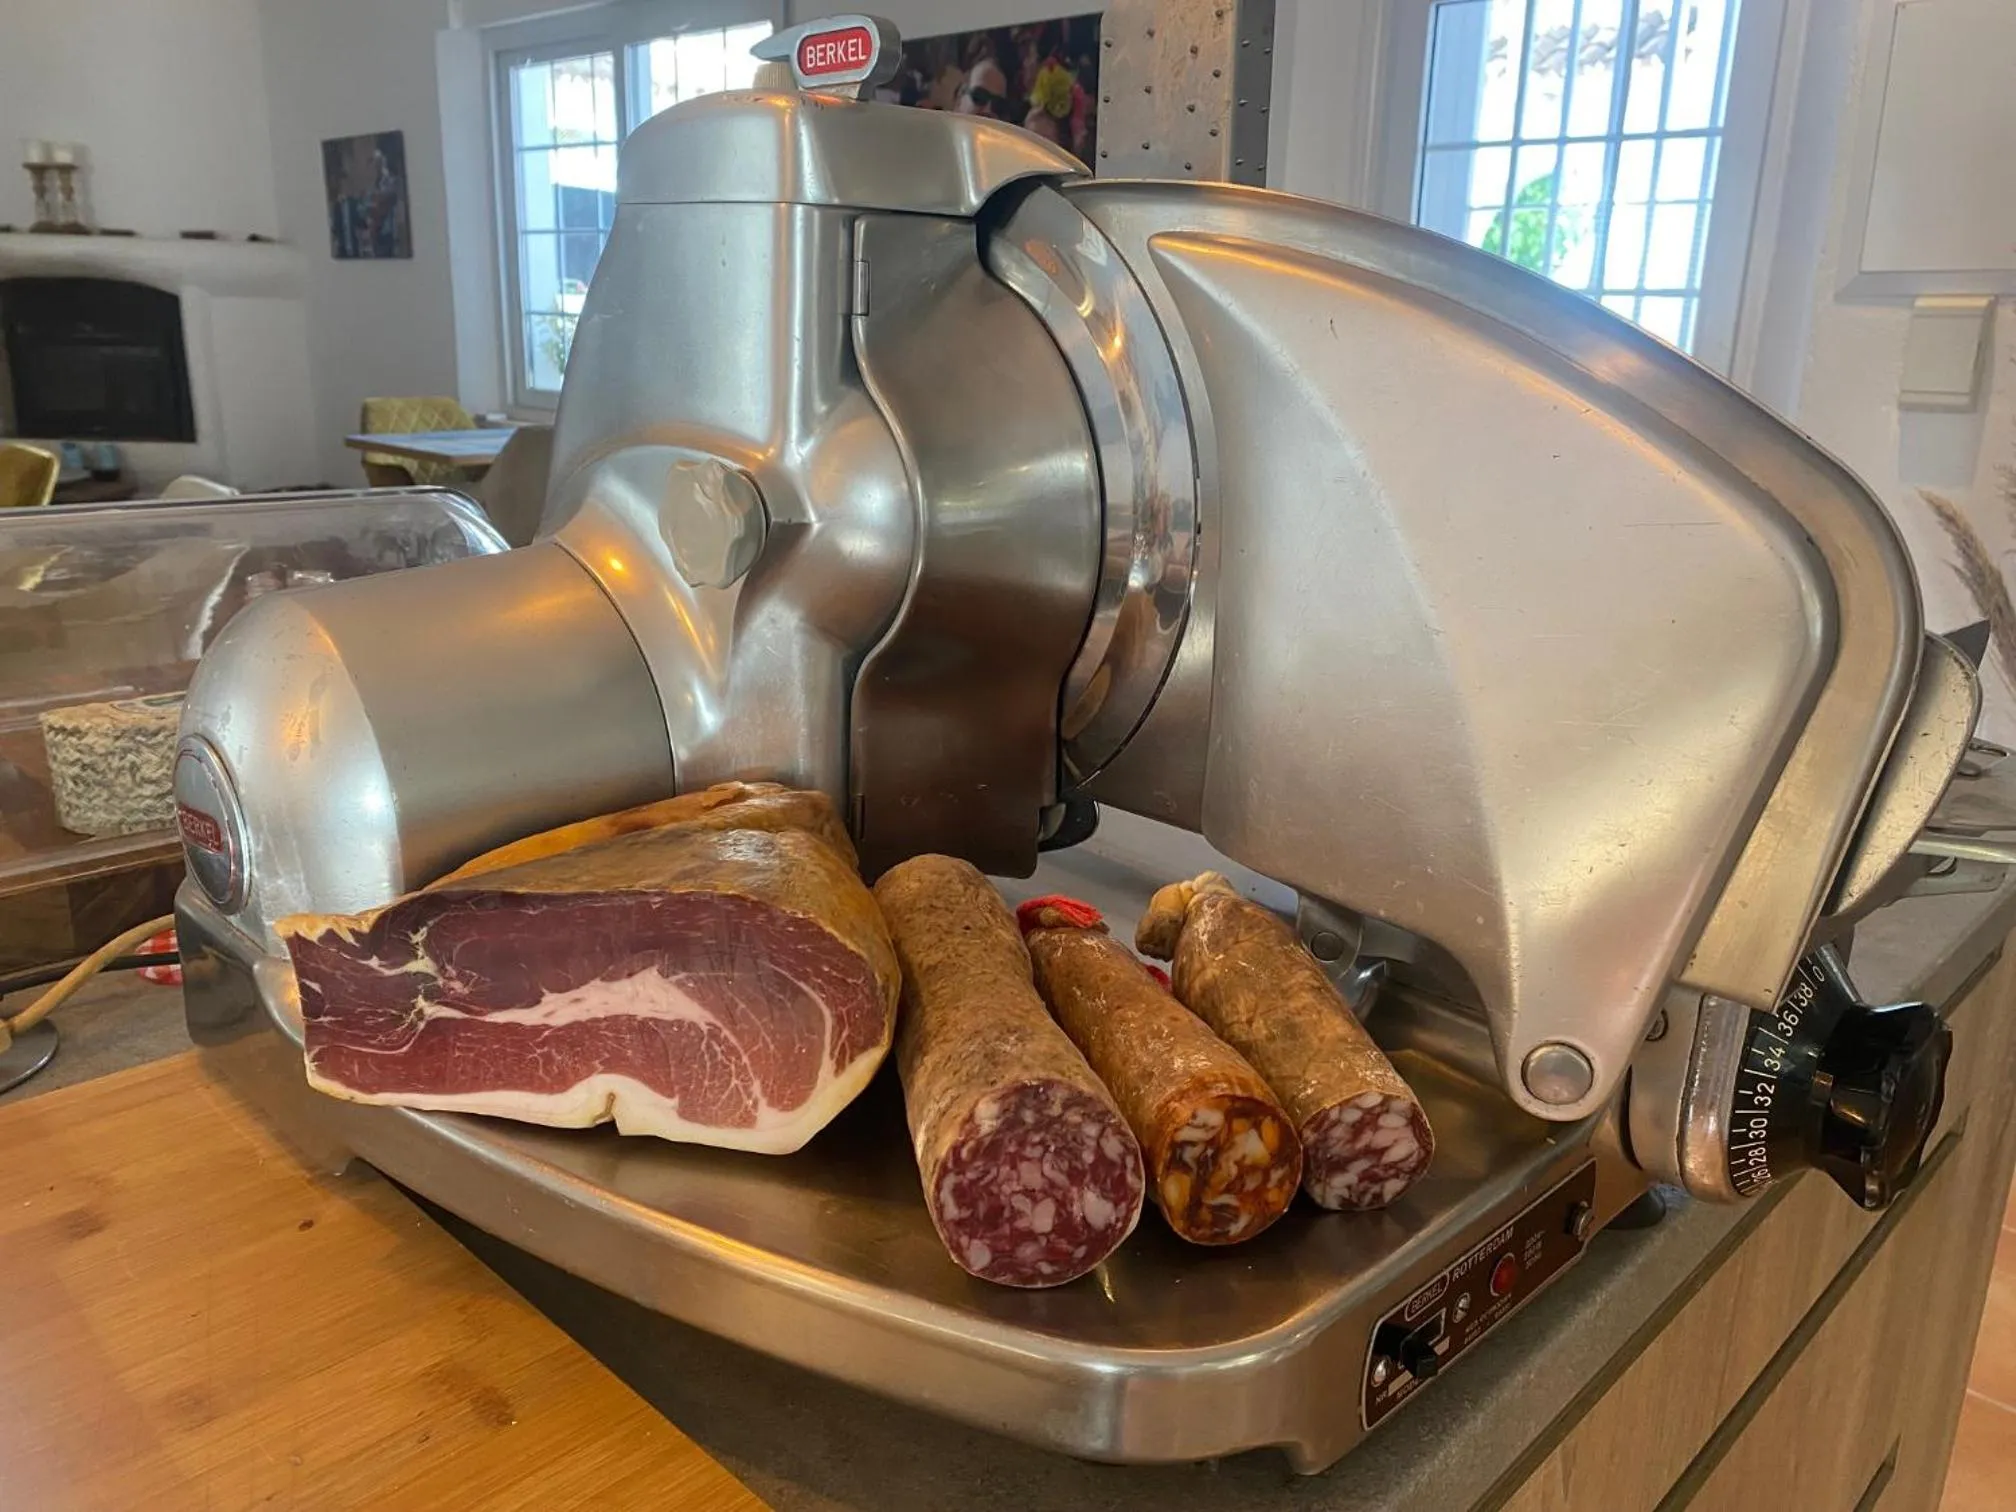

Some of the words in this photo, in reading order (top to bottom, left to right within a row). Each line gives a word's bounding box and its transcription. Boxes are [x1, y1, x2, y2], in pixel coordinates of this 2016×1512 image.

[806, 38, 867, 69] BERKEL
[1797, 981, 1814, 1008] 38
[1777, 1012, 1799, 1037] 36
[1764, 1046, 1786, 1071] 34
[1754, 1082, 1775, 1107] 32
[1749, 1117, 1768, 1138] 30
[1748, 1146, 1767, 1167] 28
[1410, 1282, 1443, 1312] BERKEL
[1452, 1226, 1515, 1282] ROTTERDAM
